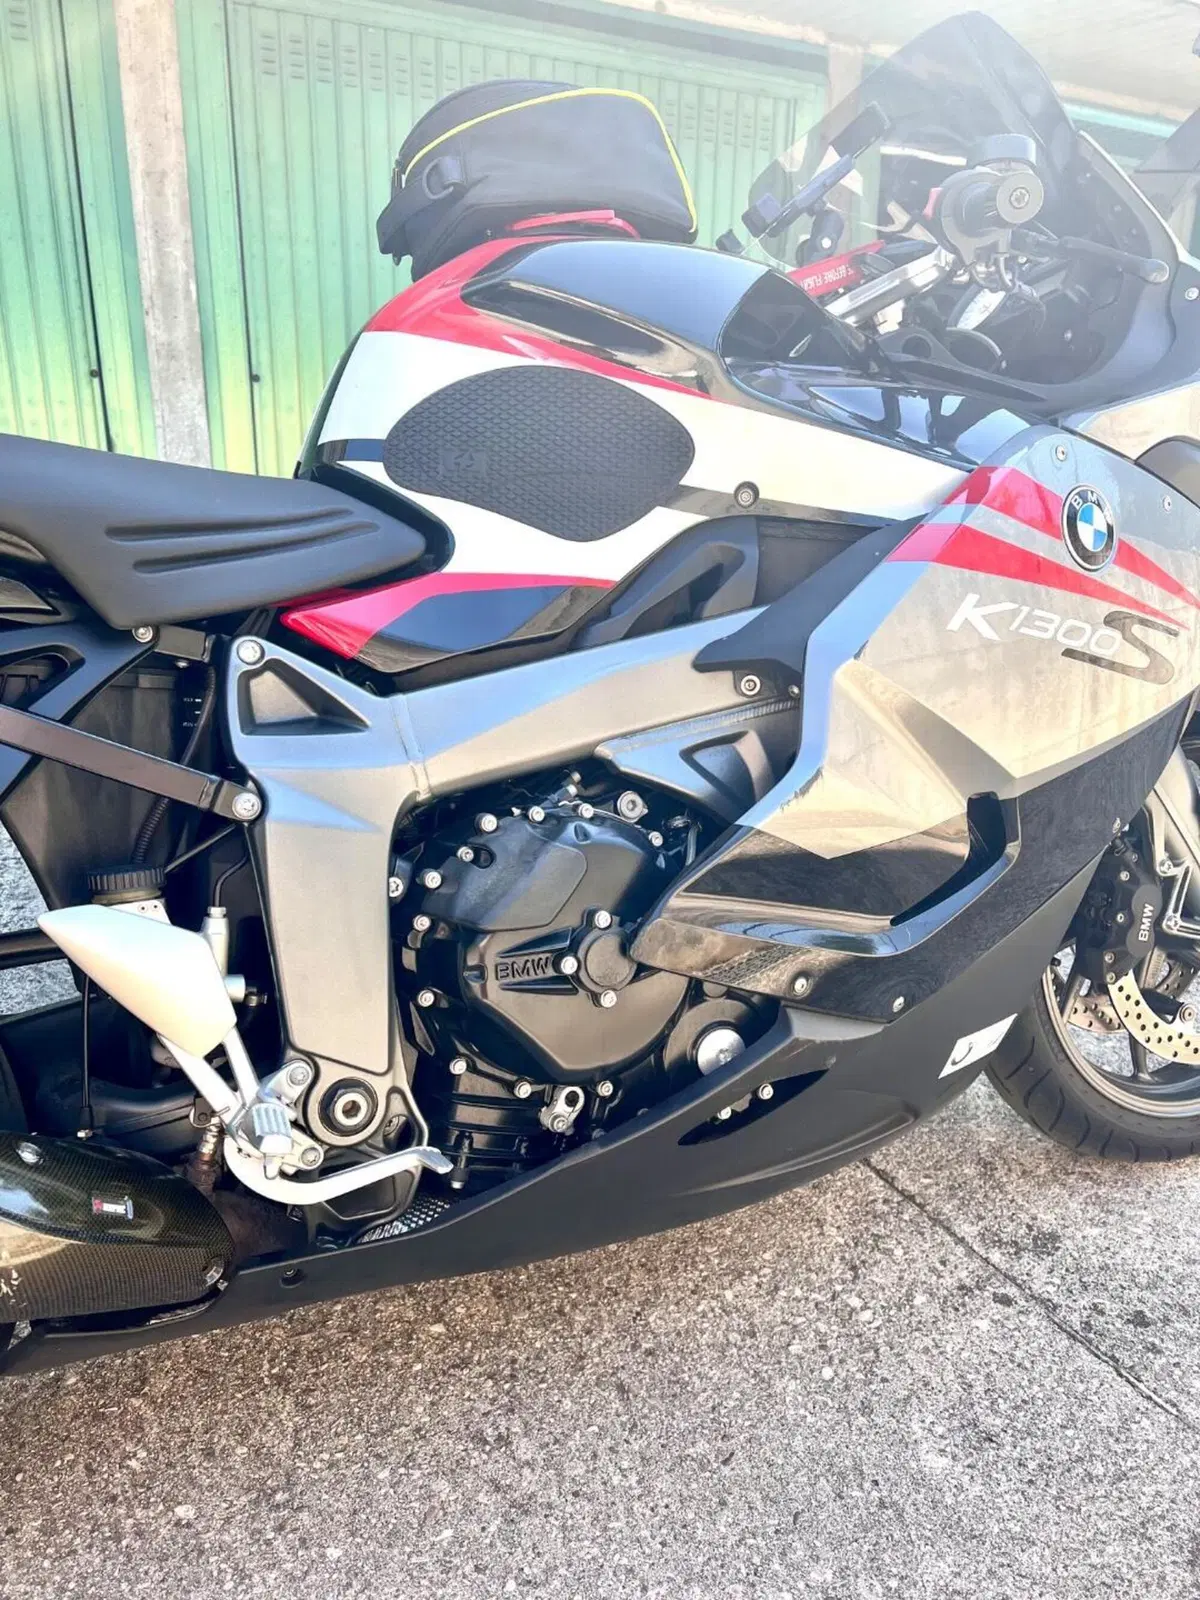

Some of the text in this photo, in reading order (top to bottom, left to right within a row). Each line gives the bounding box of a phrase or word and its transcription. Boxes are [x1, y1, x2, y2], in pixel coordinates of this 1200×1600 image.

[1070, 490, 1113, 526] BMW
[1138, 902, 1154, 942] BMW
[494, 956, 550, 981] BMW
